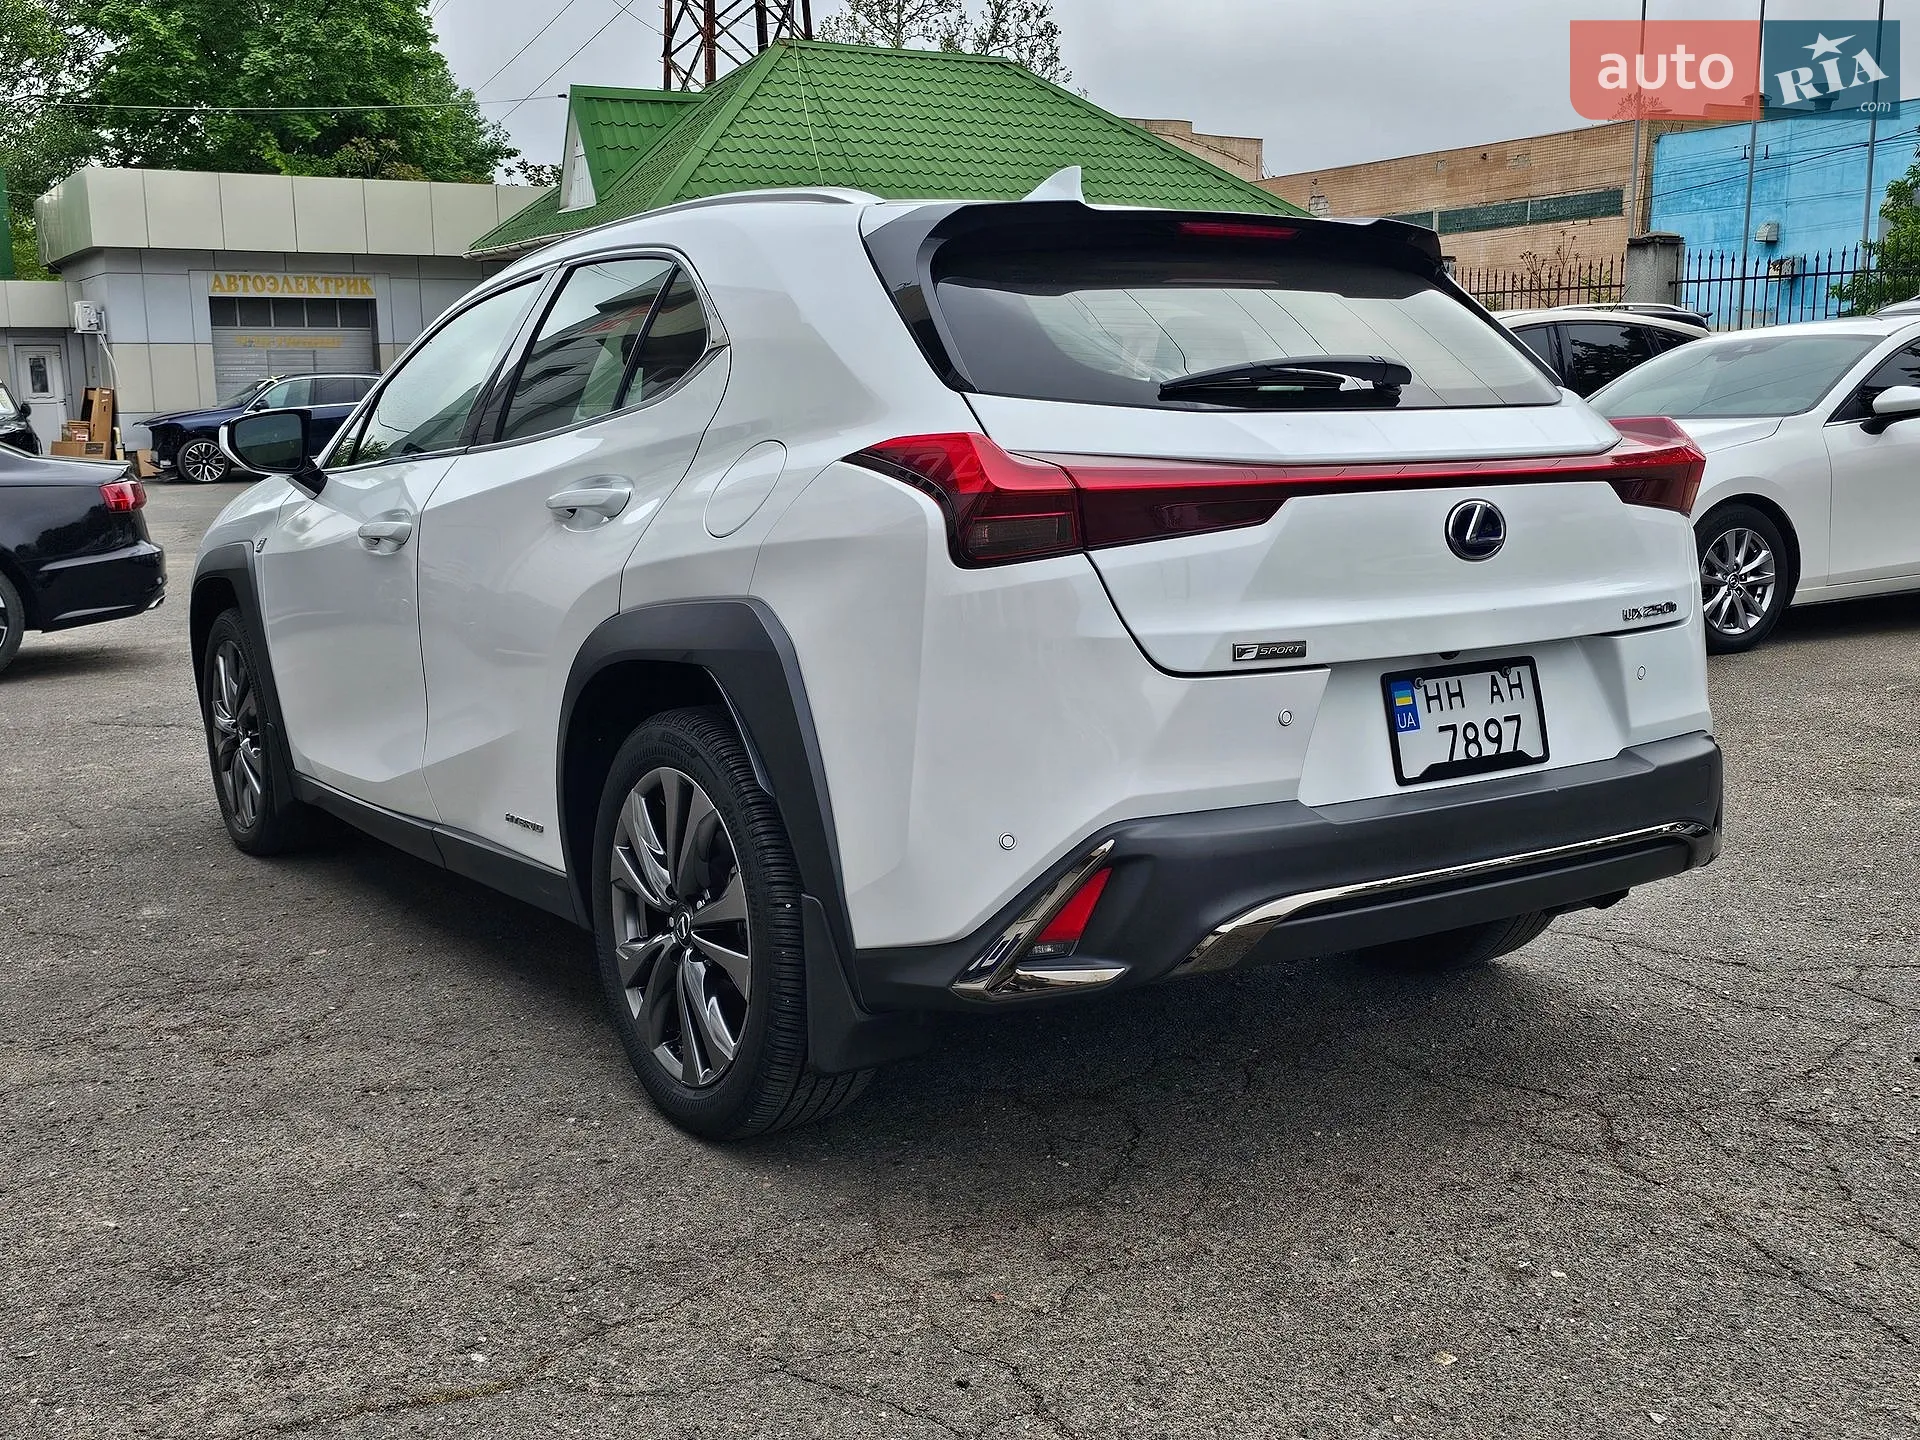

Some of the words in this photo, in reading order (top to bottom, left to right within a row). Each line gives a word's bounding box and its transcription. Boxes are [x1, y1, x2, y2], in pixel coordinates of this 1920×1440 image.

[212, 274, 373, 295] АВТОЭЛЕКТРИК
[1260, 645, 1303, 655] SPORT
[1423, 679, 1465, 713] HH
[1489, 671, 1525, 705] AH
[1397, 712, 1417, 729] UA
[1438, 713, 1522, 762] 7897
